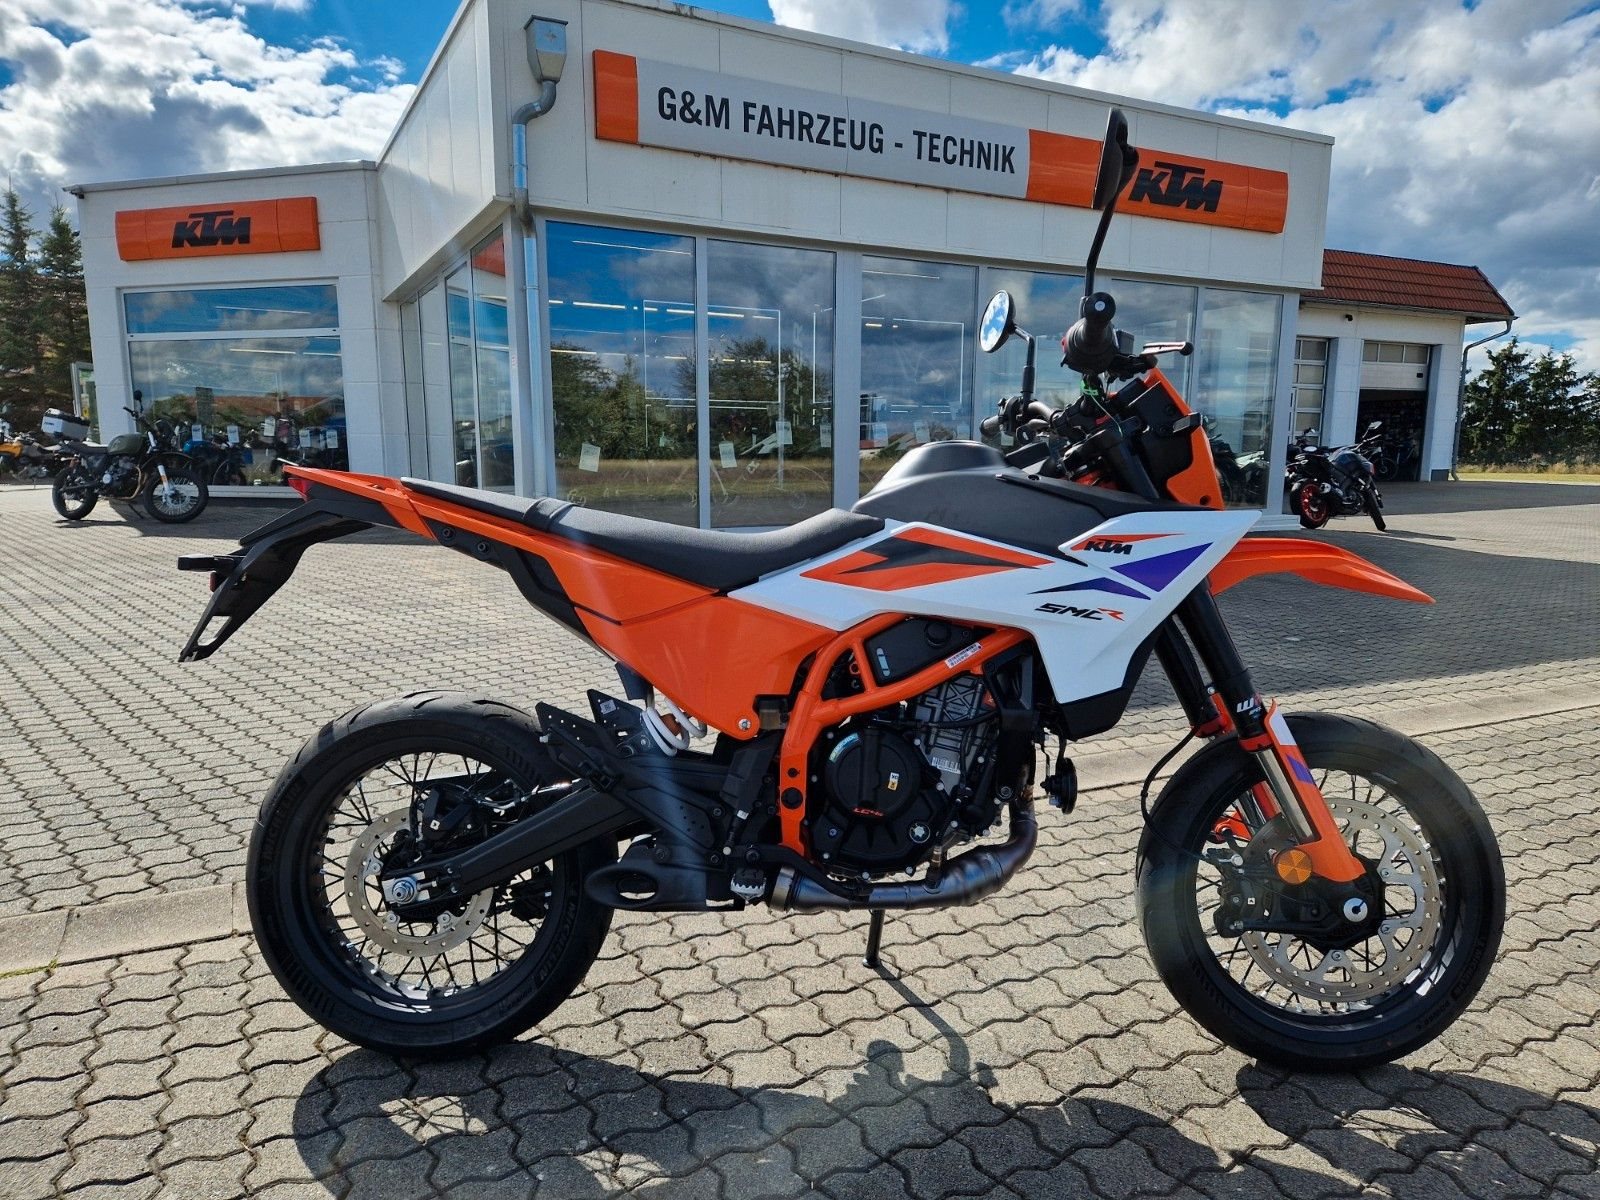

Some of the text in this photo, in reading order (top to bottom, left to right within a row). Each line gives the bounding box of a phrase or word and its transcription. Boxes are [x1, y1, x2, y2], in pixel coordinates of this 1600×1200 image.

[658, 86, 730, 130] G&M
[742, 100, 884, 154] FAHRZEUG
[912, 129, 1016, 174] TECHNIK
[1128, 160, 1224, 213] KTM
[171, 210, 251, 248] KTM
[1084, 538, 1133, 555] KTM
